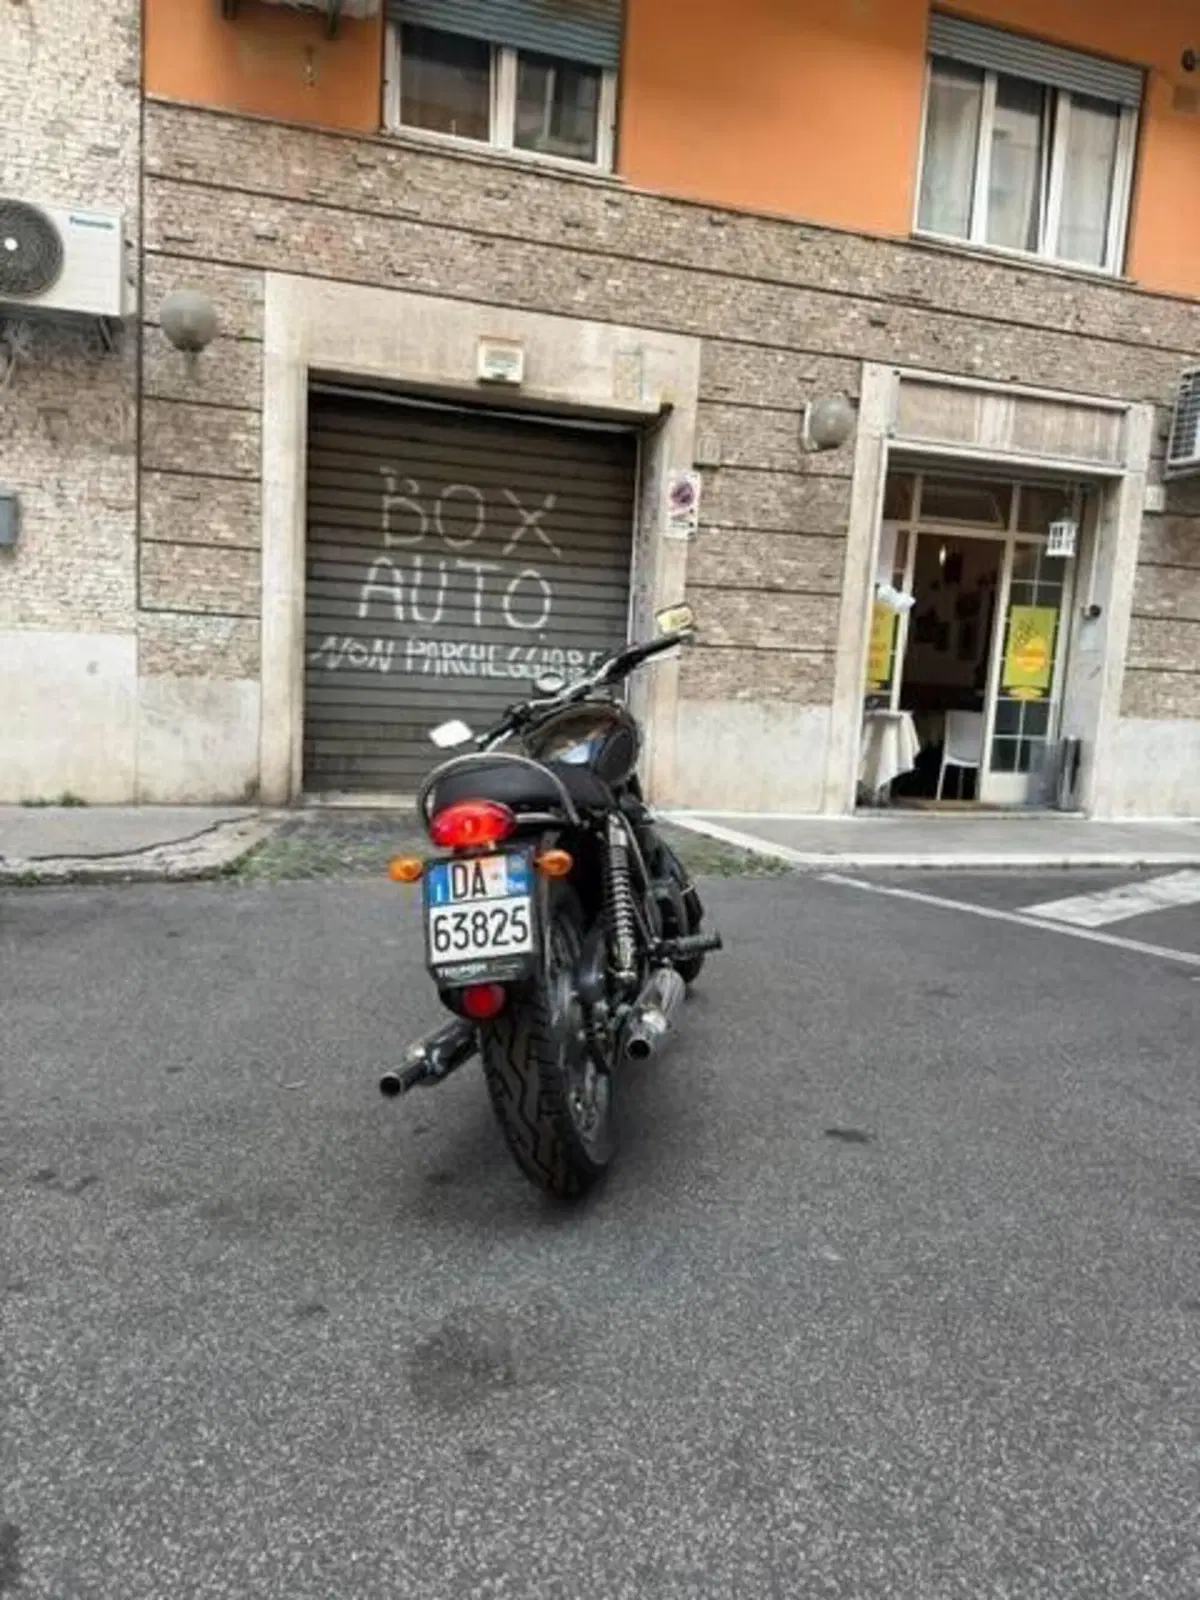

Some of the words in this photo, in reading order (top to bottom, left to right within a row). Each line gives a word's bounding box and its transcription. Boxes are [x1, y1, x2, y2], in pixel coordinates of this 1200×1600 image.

[379, 466, 561, 557] BOX
[357, 554, 552, 630] AUTO
[309, 636, 396, 673] NON
[452, 861, 487, 898] DA
[433, 905, 528, 952] 63825
